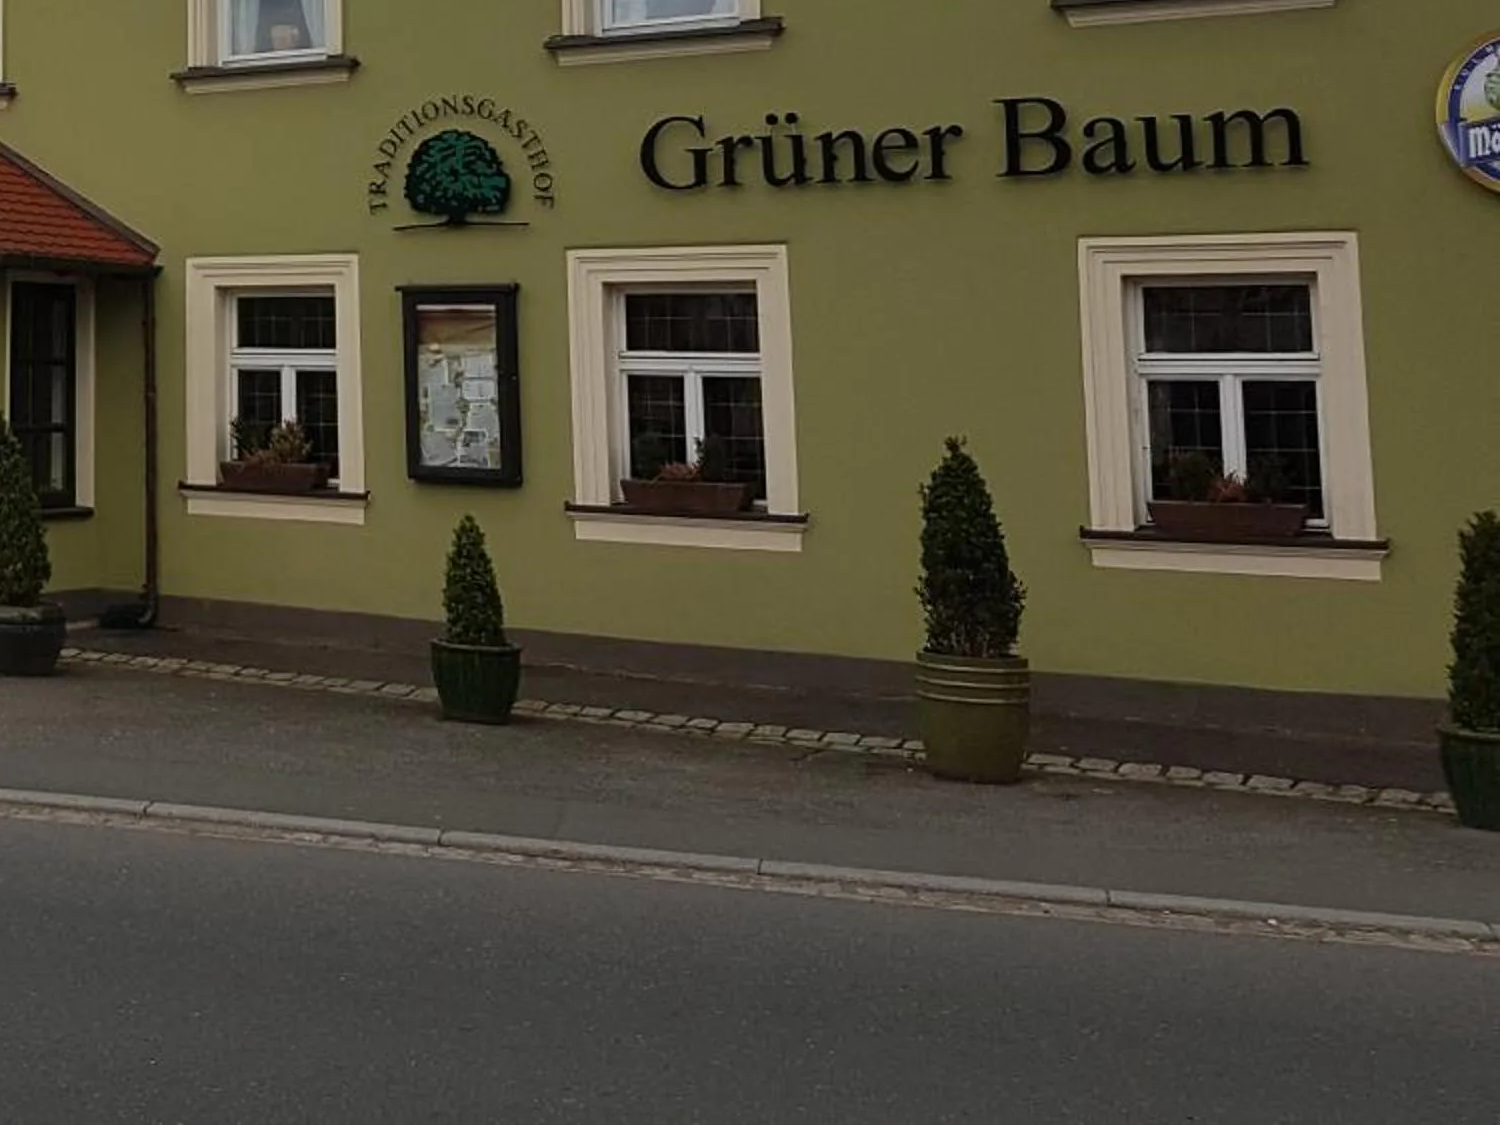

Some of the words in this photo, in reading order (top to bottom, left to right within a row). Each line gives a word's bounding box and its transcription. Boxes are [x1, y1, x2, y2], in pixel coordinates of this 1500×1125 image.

[369, 94, 555, 215] TRADITIONSGASTHOF
[639, 112, 963, 190] Grüner
[992, 96, 1310, 178] Baum
